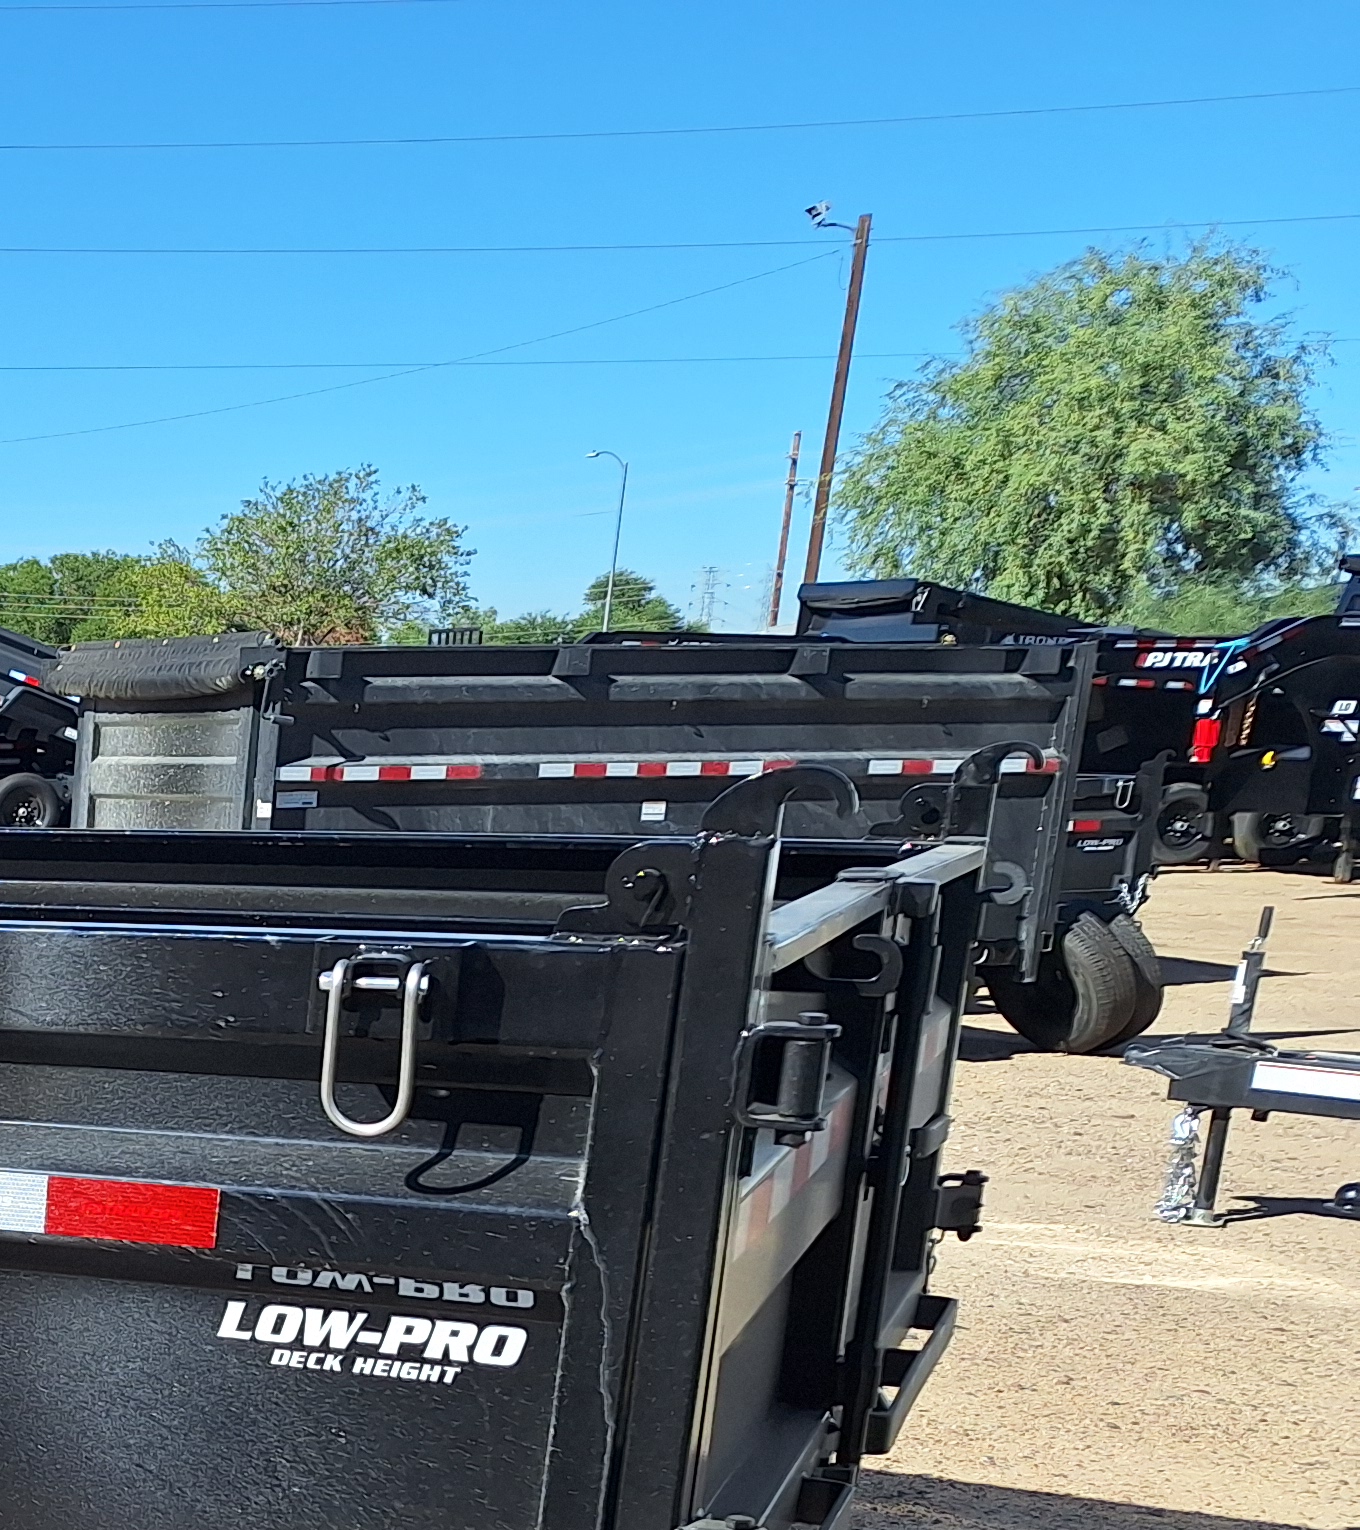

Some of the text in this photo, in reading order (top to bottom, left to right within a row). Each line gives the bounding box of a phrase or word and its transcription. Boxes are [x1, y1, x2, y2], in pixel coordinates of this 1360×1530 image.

[216, 1300, 528, 1367] LOW-PRO
[269, 1347, 463, 1385] DECK HEIGHT
